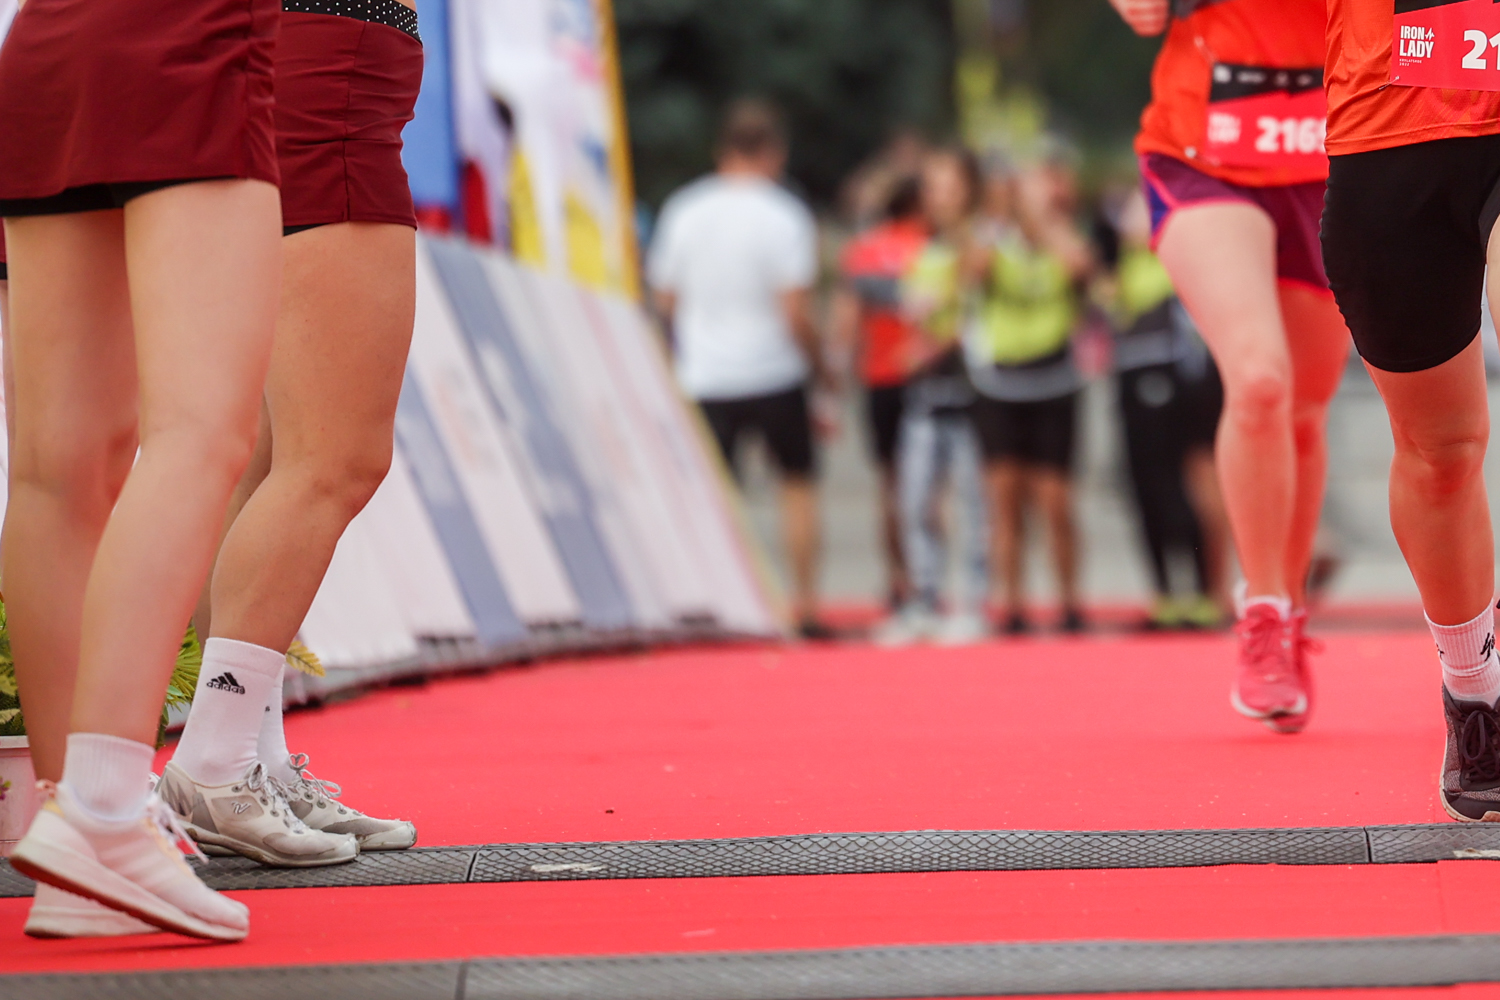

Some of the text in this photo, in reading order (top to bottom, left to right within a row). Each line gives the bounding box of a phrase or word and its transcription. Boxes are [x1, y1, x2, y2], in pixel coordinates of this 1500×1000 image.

[1400, 25, 1425, 40] IRON
[1399, 39, 1434, 58] LADY
[206, 681, 245, 695] adidas
